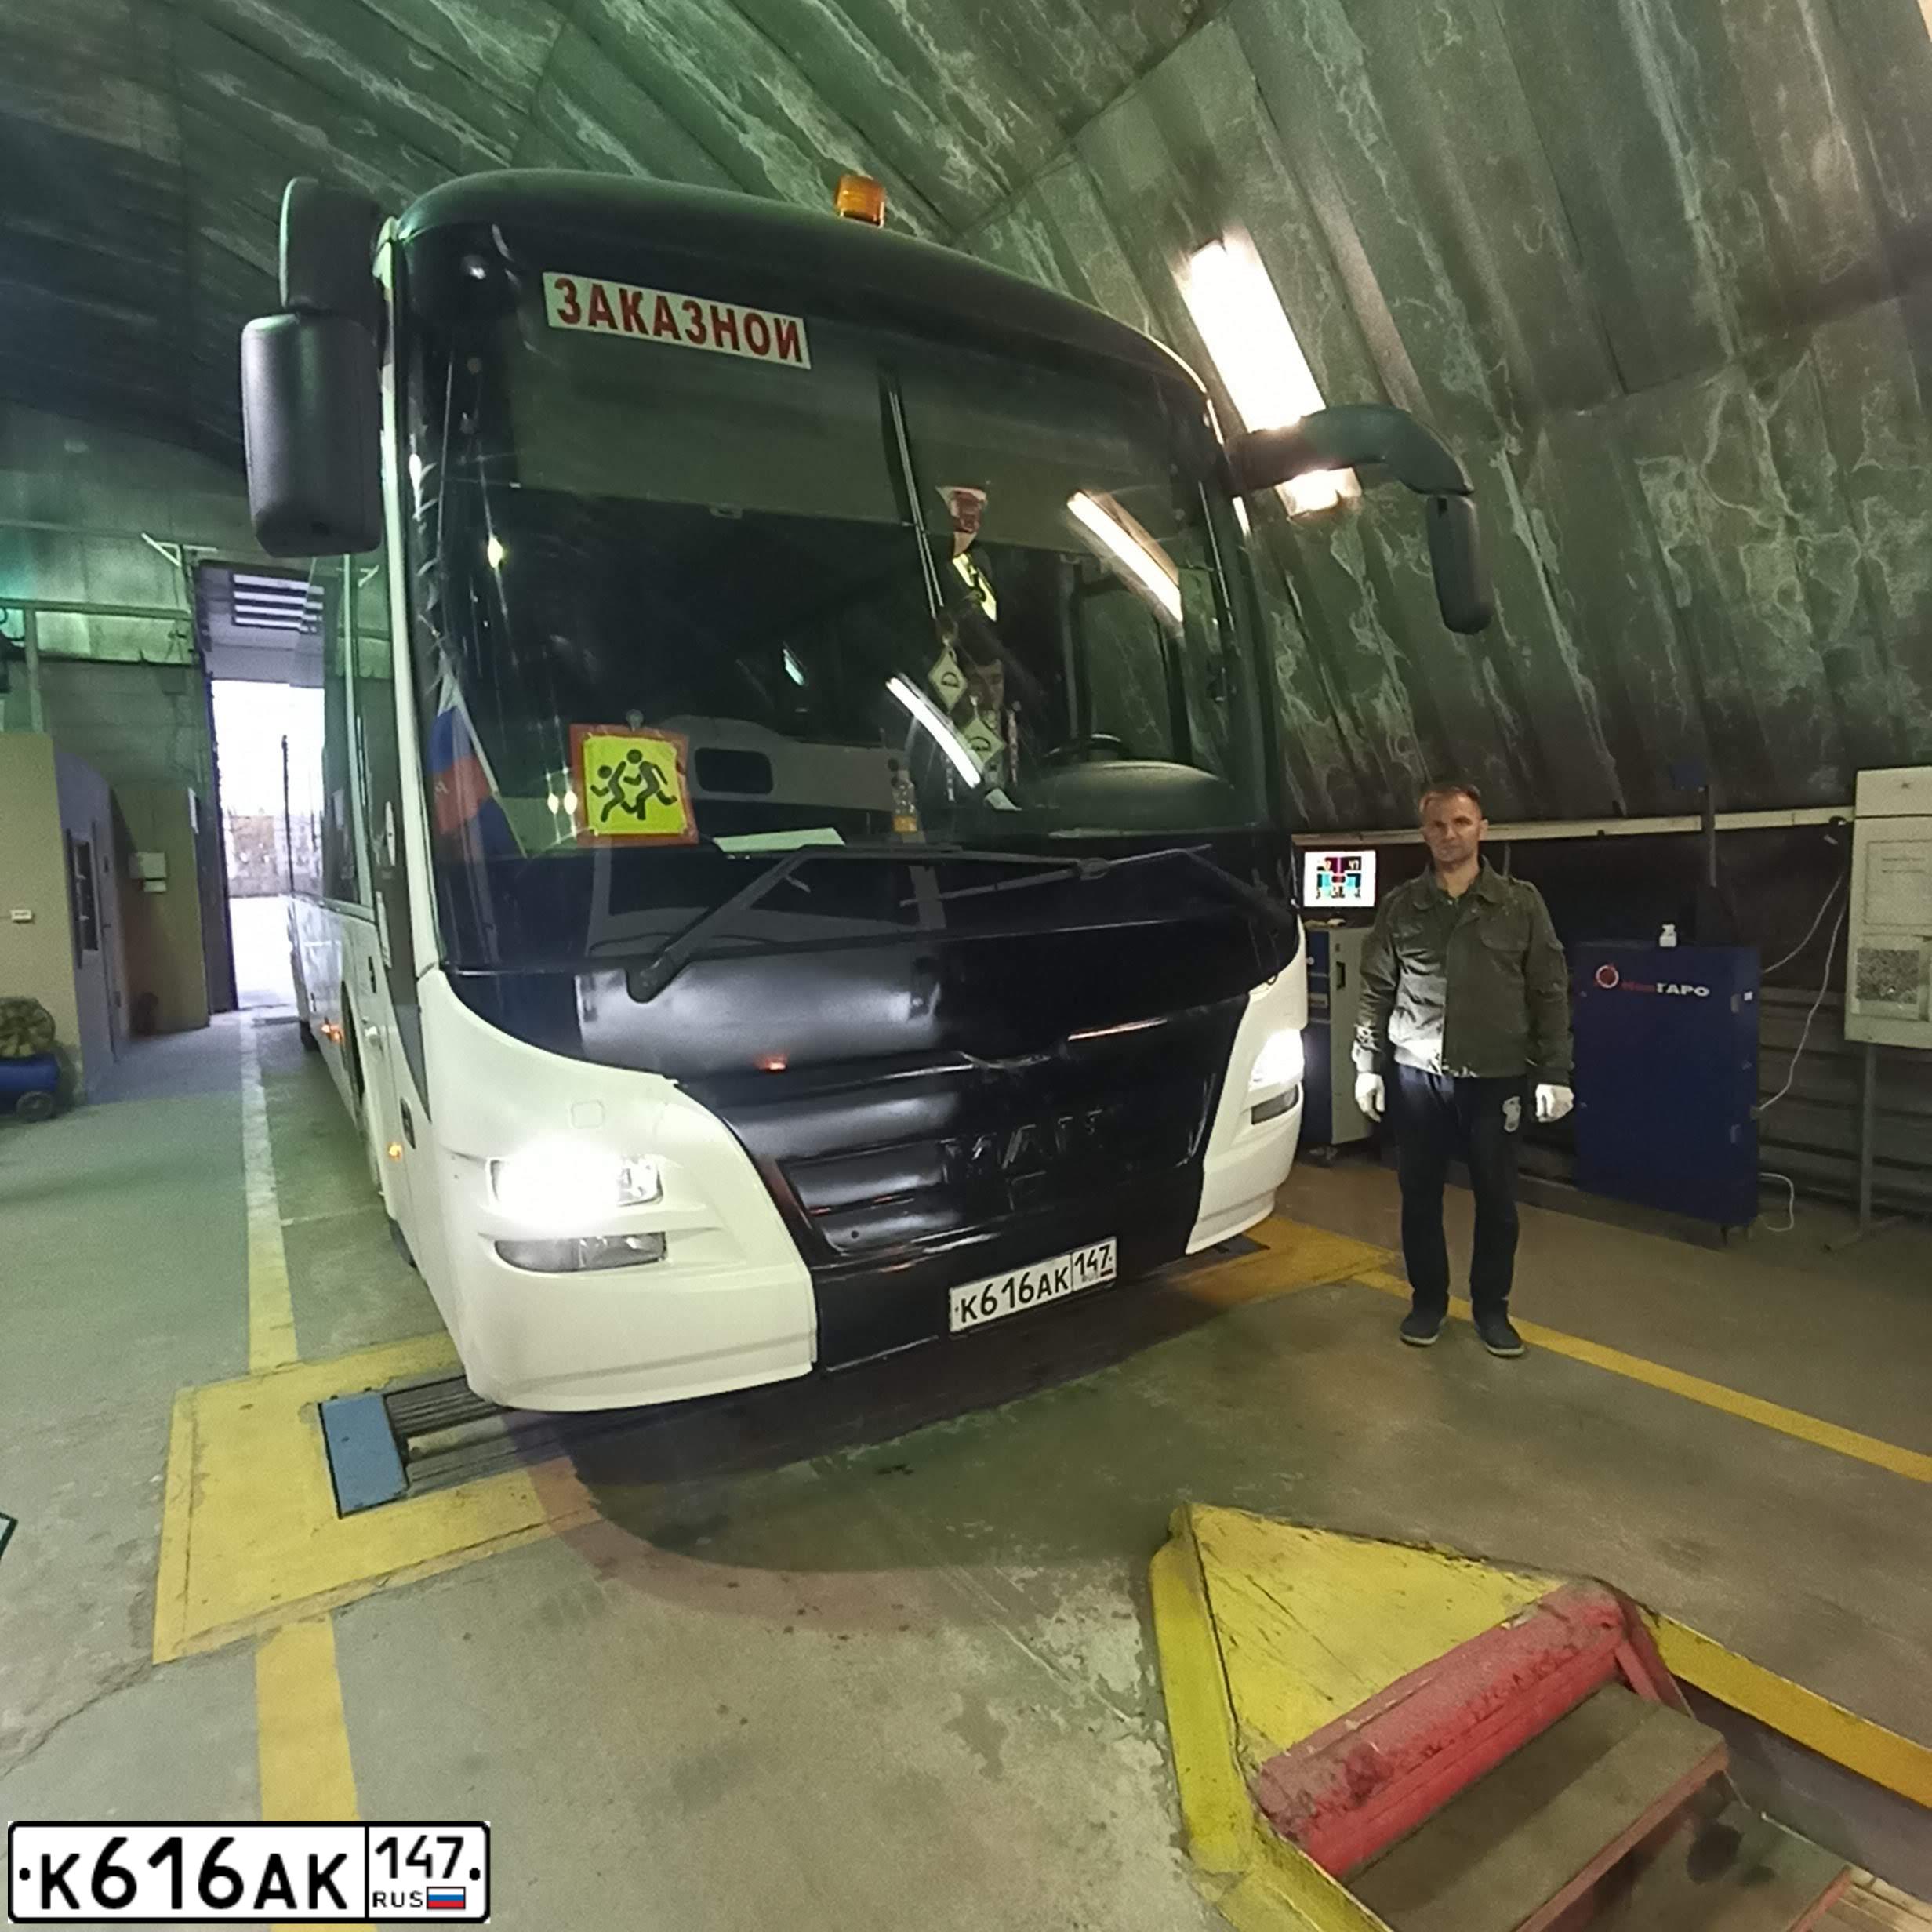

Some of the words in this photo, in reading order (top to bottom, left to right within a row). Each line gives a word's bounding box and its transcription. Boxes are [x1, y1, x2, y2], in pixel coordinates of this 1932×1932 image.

[554, 277, 803, 363] ЗАКАЗНОЙ
[960, 1266, 1069, 1323] К616АК
[1074, 1244, 1110, 1275] 147
